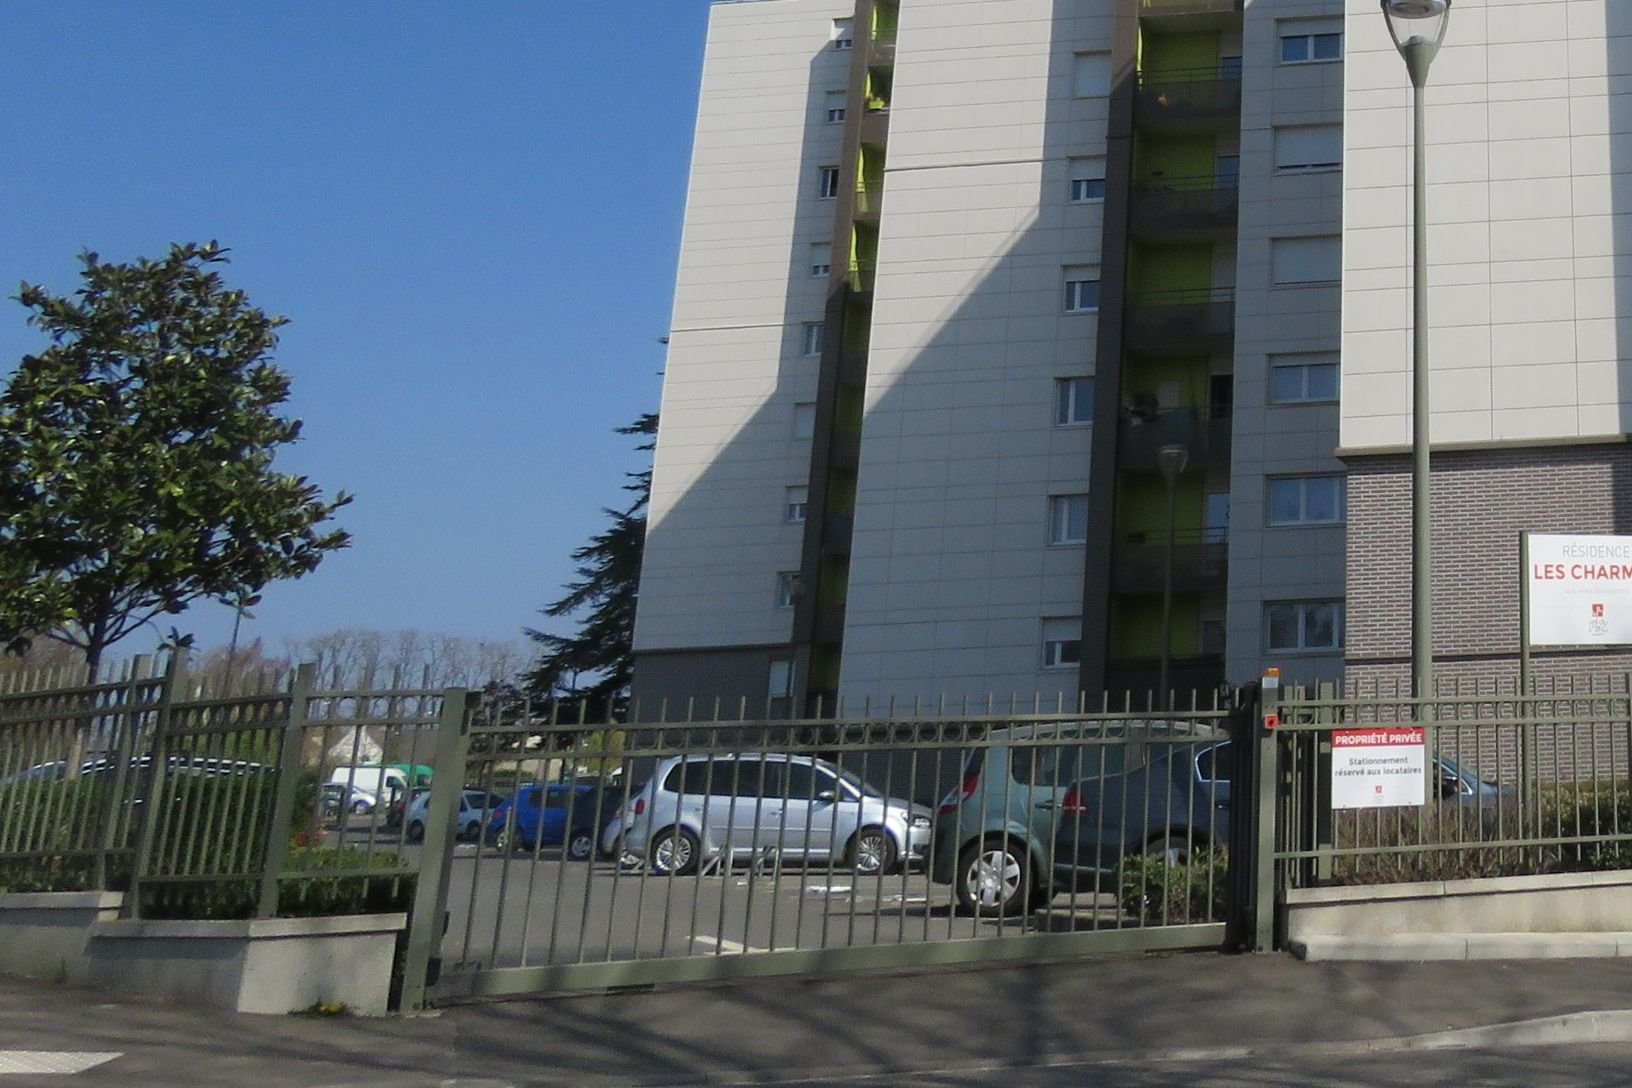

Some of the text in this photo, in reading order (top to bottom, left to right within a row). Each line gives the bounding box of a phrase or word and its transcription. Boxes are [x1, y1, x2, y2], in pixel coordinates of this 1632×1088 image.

[1562, 543, 1630, 558] RÉSIDENCE
[1534, 564, 1565, 580] LES
[1335, 731, 1422, 745] PROPRIÉTÉ PRIVÉE
[1349, 757, 1408, 766] Stationnement
[1335, 768, 1365, 777] réservé
[1383, 767, 1422, 775] locataires
